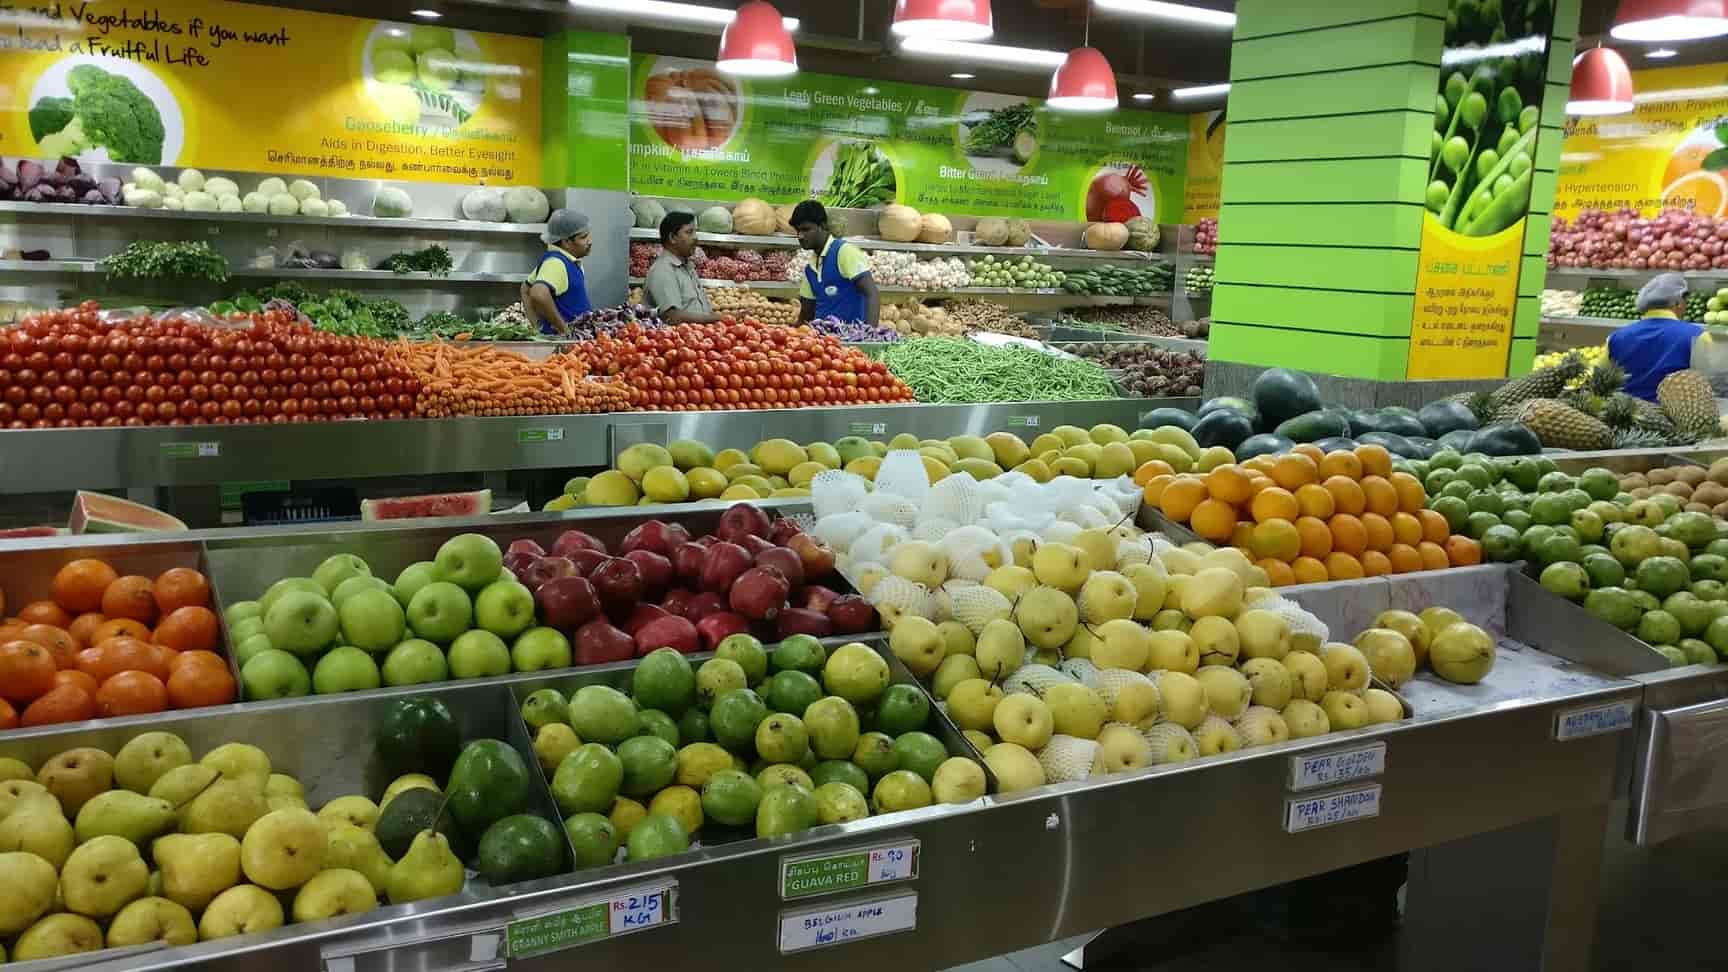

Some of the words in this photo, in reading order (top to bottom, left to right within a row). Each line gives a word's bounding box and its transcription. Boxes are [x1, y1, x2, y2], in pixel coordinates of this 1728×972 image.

[70, 1, 183, 35] Vegetables
[189, 18, 204, 36] if
[209, 24, 238, 47] you
[243, 27, 291, 47] want
[87, 36, 160, 62] Fruitful
[166, 48, 209, 67] Life
[814, 91, 845, 106] Green
[847, 94, 903, 113] Vegetables
[320, 137, 347, 150] Aids
[352, 140, 362, 151] in
[430, 145, 465, 158] Better
[1564, 183, 1639, 195] Hypertension
[1304, 758, 1331, 776] PEAR
[1297, 799, 1326, 817] PEAR
[791, 874, 833, 890] GUAVA
[835, 871, 859, 884] RED
[628, 891, 664, 911] 215
[511, 932, 548, 952] GRANNY
[550, 926, 578, 945] SMITH
